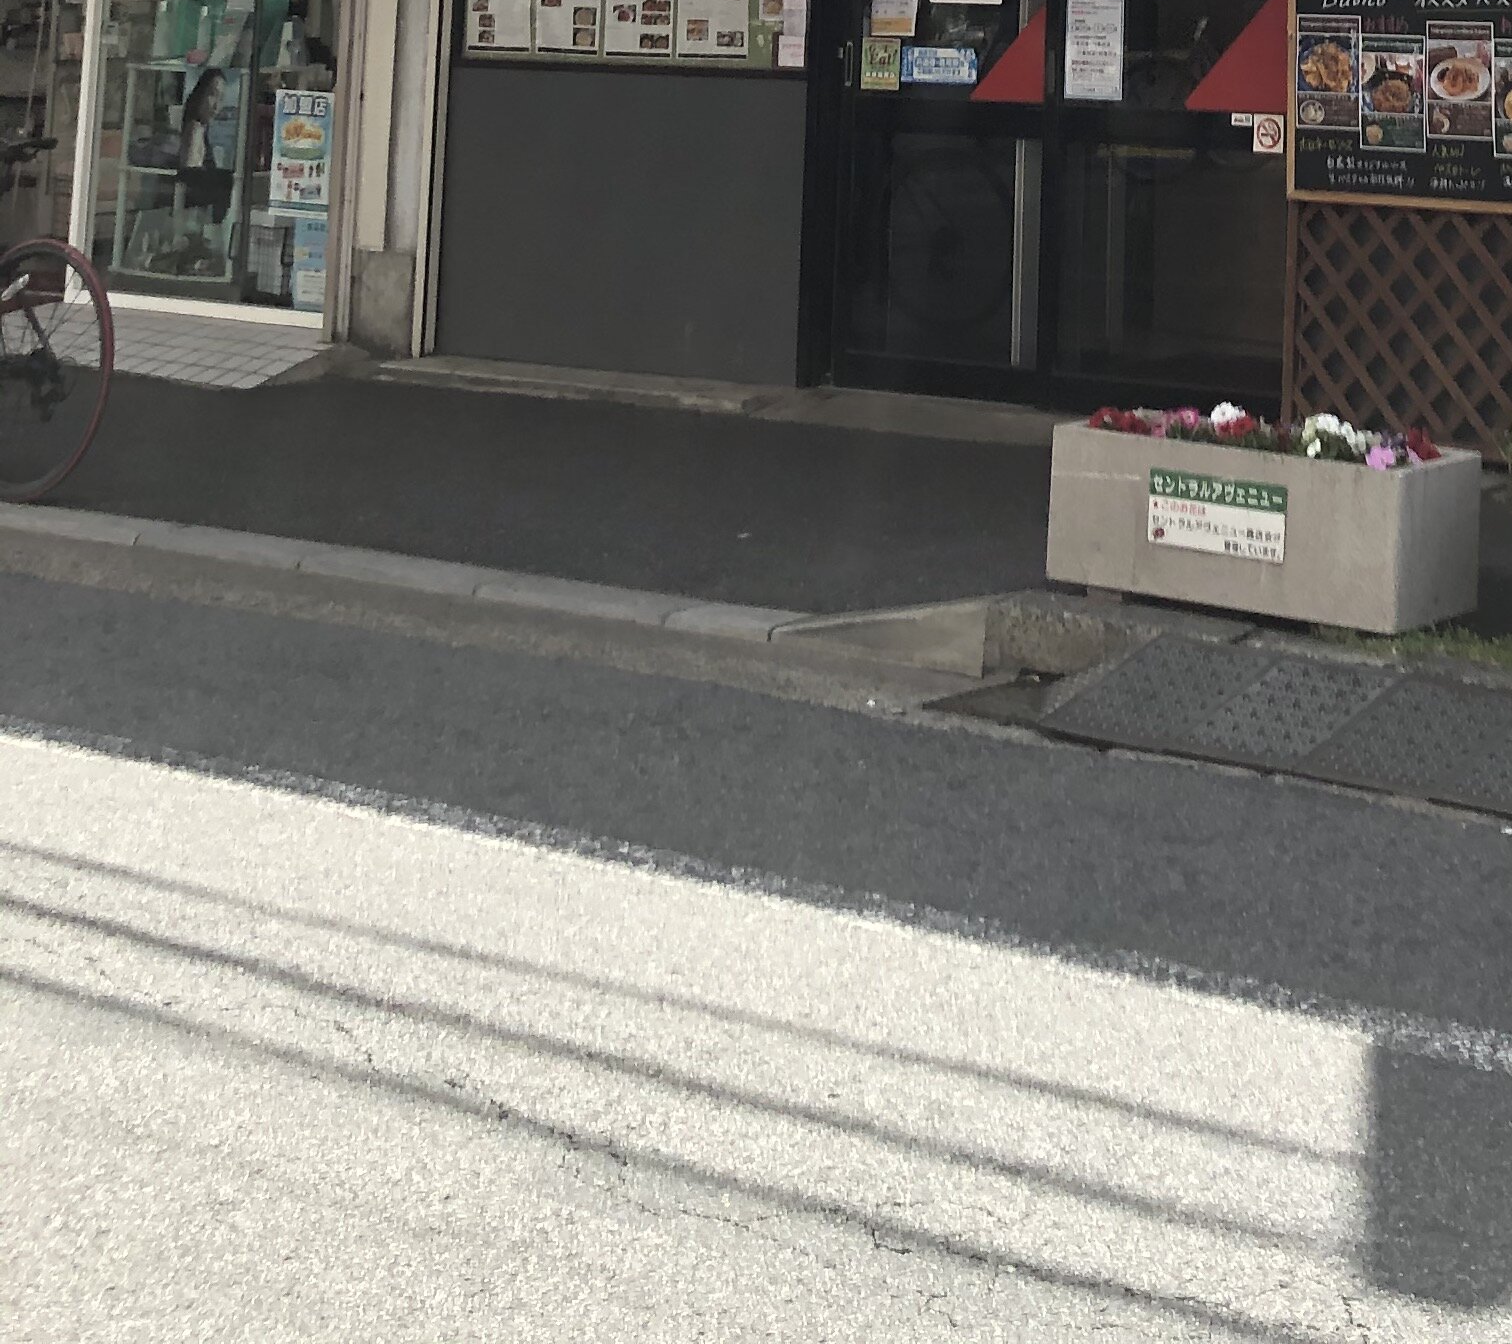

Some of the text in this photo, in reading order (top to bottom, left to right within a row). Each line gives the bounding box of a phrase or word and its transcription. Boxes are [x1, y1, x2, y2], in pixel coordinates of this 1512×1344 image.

[1153, 473, 1283, 508] セントラルアヴェニュー
